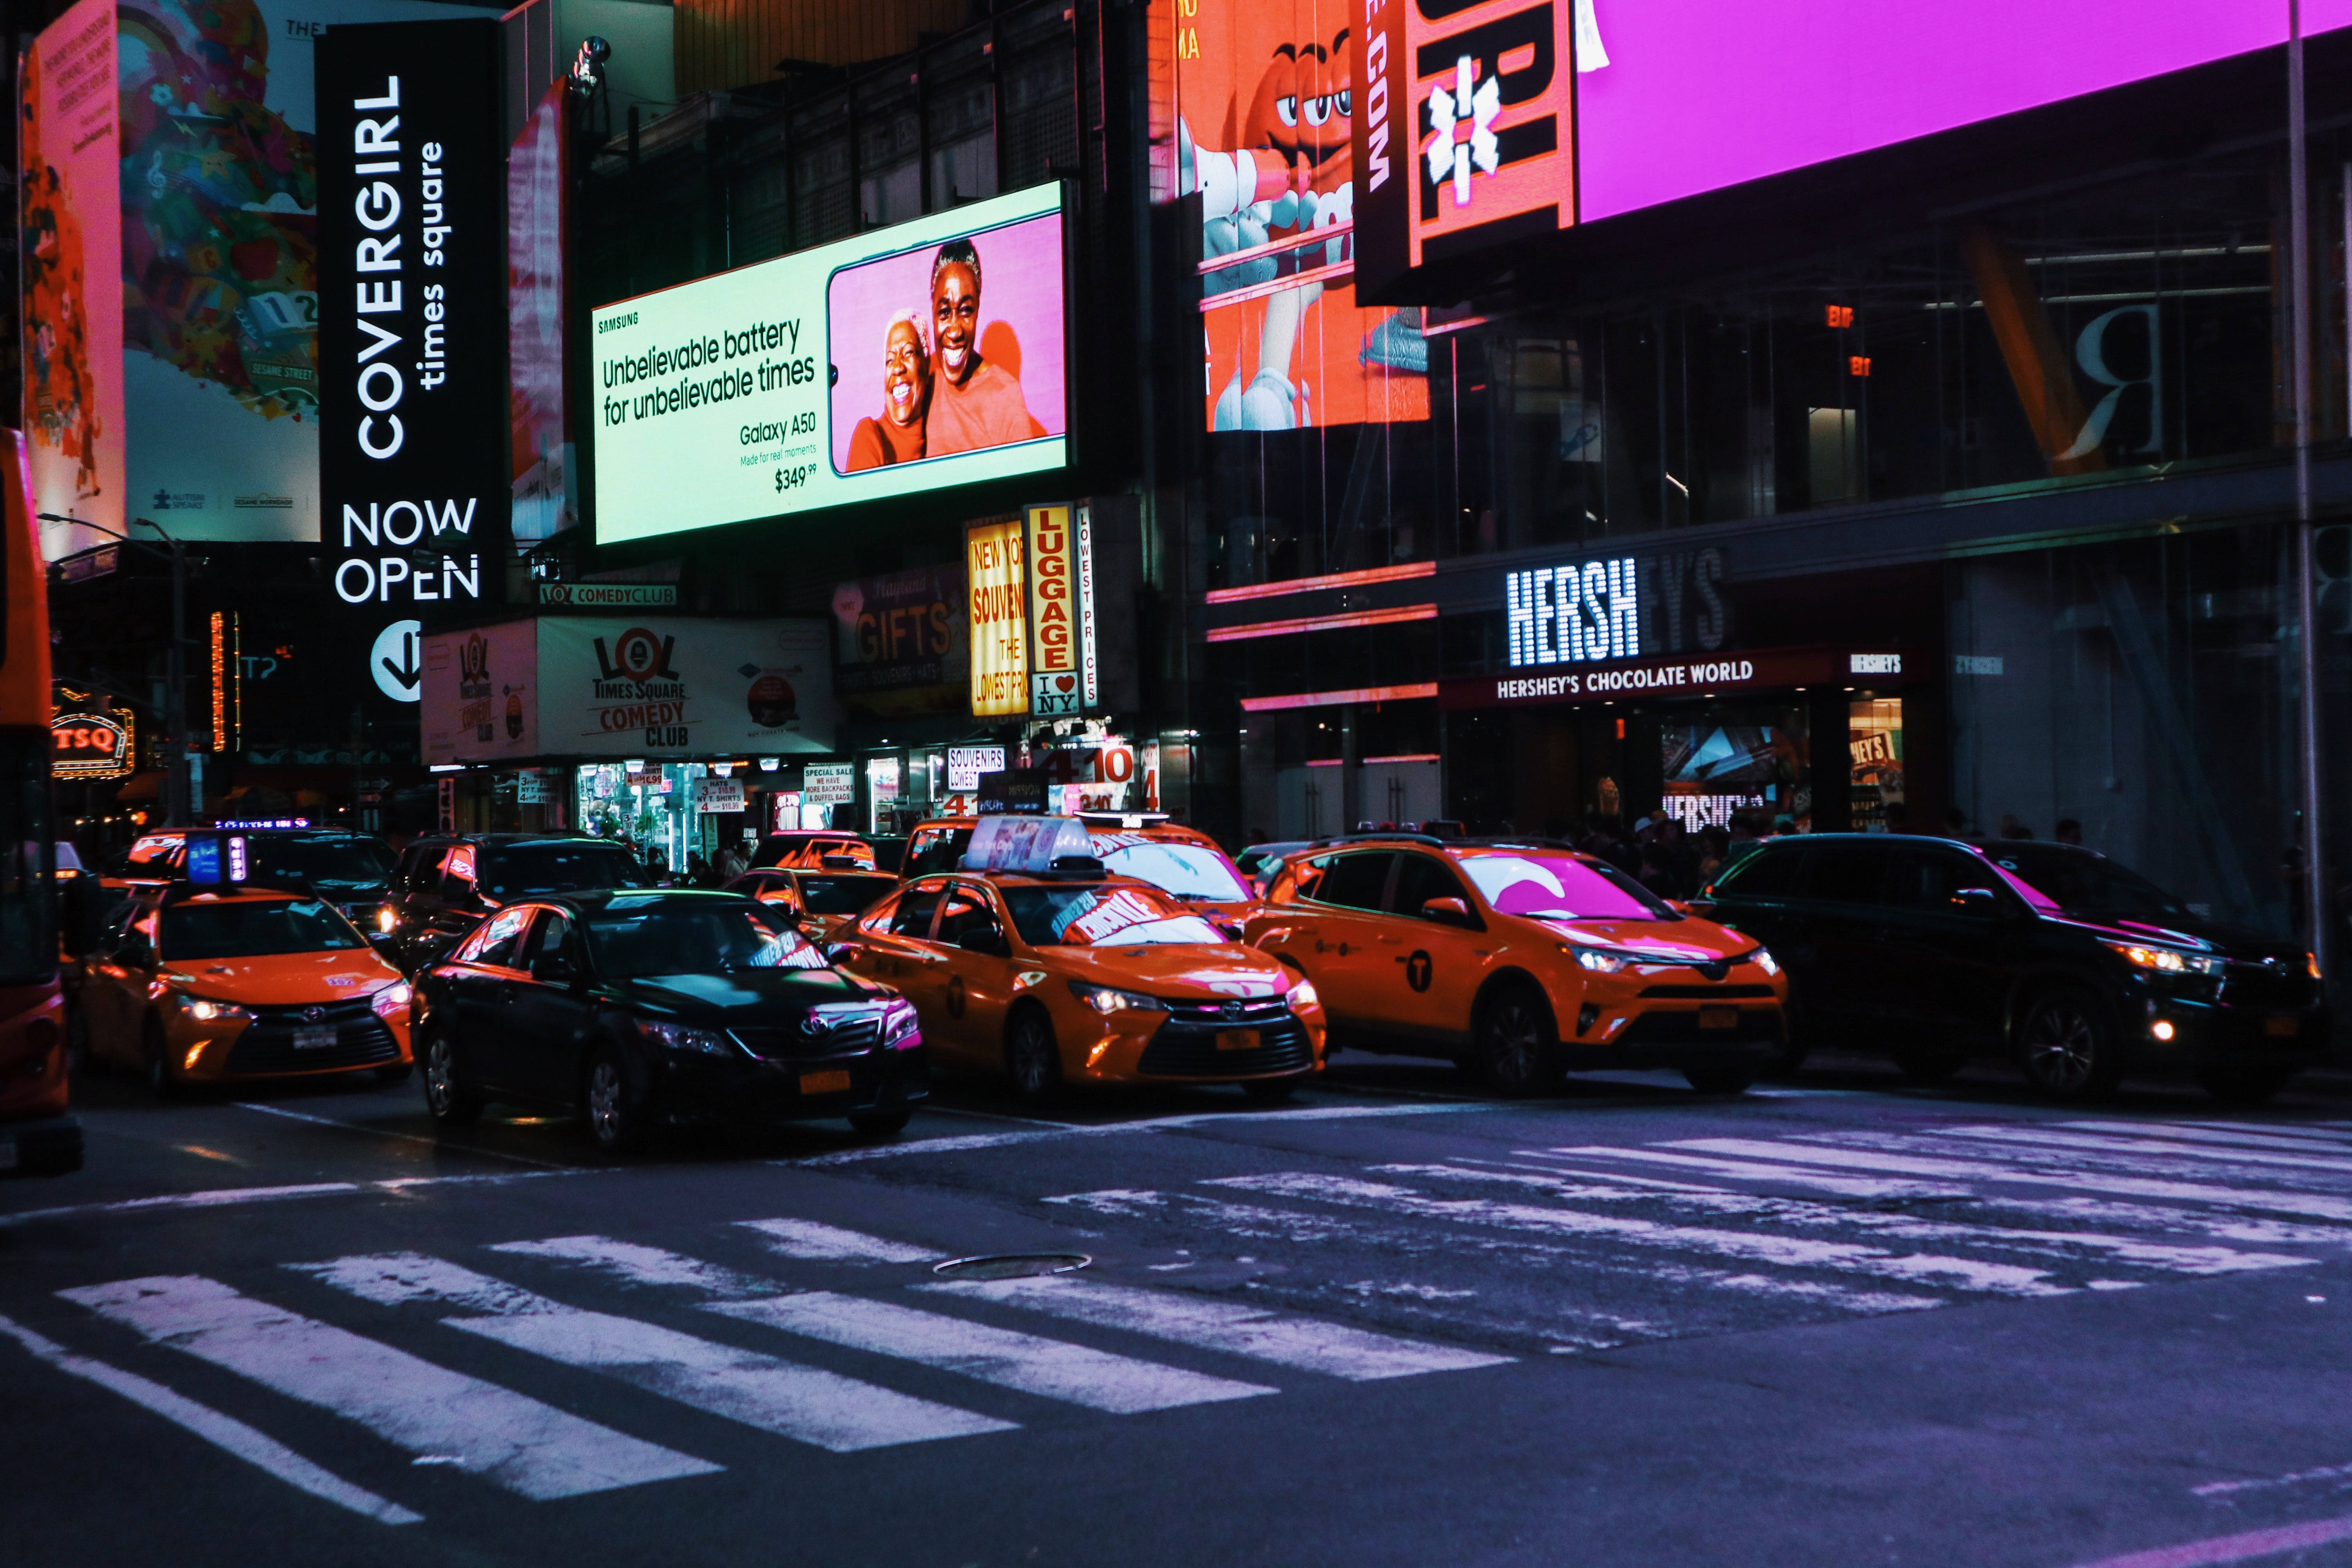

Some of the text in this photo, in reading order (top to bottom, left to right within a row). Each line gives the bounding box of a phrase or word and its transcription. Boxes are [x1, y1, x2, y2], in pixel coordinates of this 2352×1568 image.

[287, 20, 320, 36] THE
[354, 76, 403, 459] COVERGIRL
[421, 141, 451, 390] times square
[598, 312, 639, 334] SAMSUNG
[603, 318, 800, 388] Unbelievable battery
[252, 363, 313, 380] SESAME STREET
[604, 356, 814, 427] for unbelievable times
[740, 412, 815, 445] Galaxy A50
[740, 443, 816, 466] Made for real moments
[775, 463, 817, 493] $349.99
[343, 498, 477, 547] NOW
[975, 539, 1000, 571] NEW
[335, 554, 478, 603] OPEN
[1037, 510, 1068, 669] LUGGAGE
[1080, 513, 1095, 701] LOWEST PRICES
[856, 602, 951, 663] GIFTS
[593, 628, 679, 681] LOL
[1000, 639, 1020, 660] THE
[1851, 654, 1901, 673] HERSHEY'S
[592, 679, 686, 701] TIMES SQUARE
[976, 672, 1010, 701] LOWEST
[1497, 661, 1753, 699] HERSHEY'S CHOCOLATE WORLD
[600, 701, 684, 731] COMEDY
[1038, 694, 1075, 713] NY
[53, 728, 114, 752] TSQ
[646, 727, 688, 747] CLUB
[951, 750, 1002, 767] SOUVENIRS
[1083, 748, 1133, 782] 10
[702, 786, 708, 795] 3
[951, 771, 976, 786] LOWEST
[702, 802, 708, 811] 4
